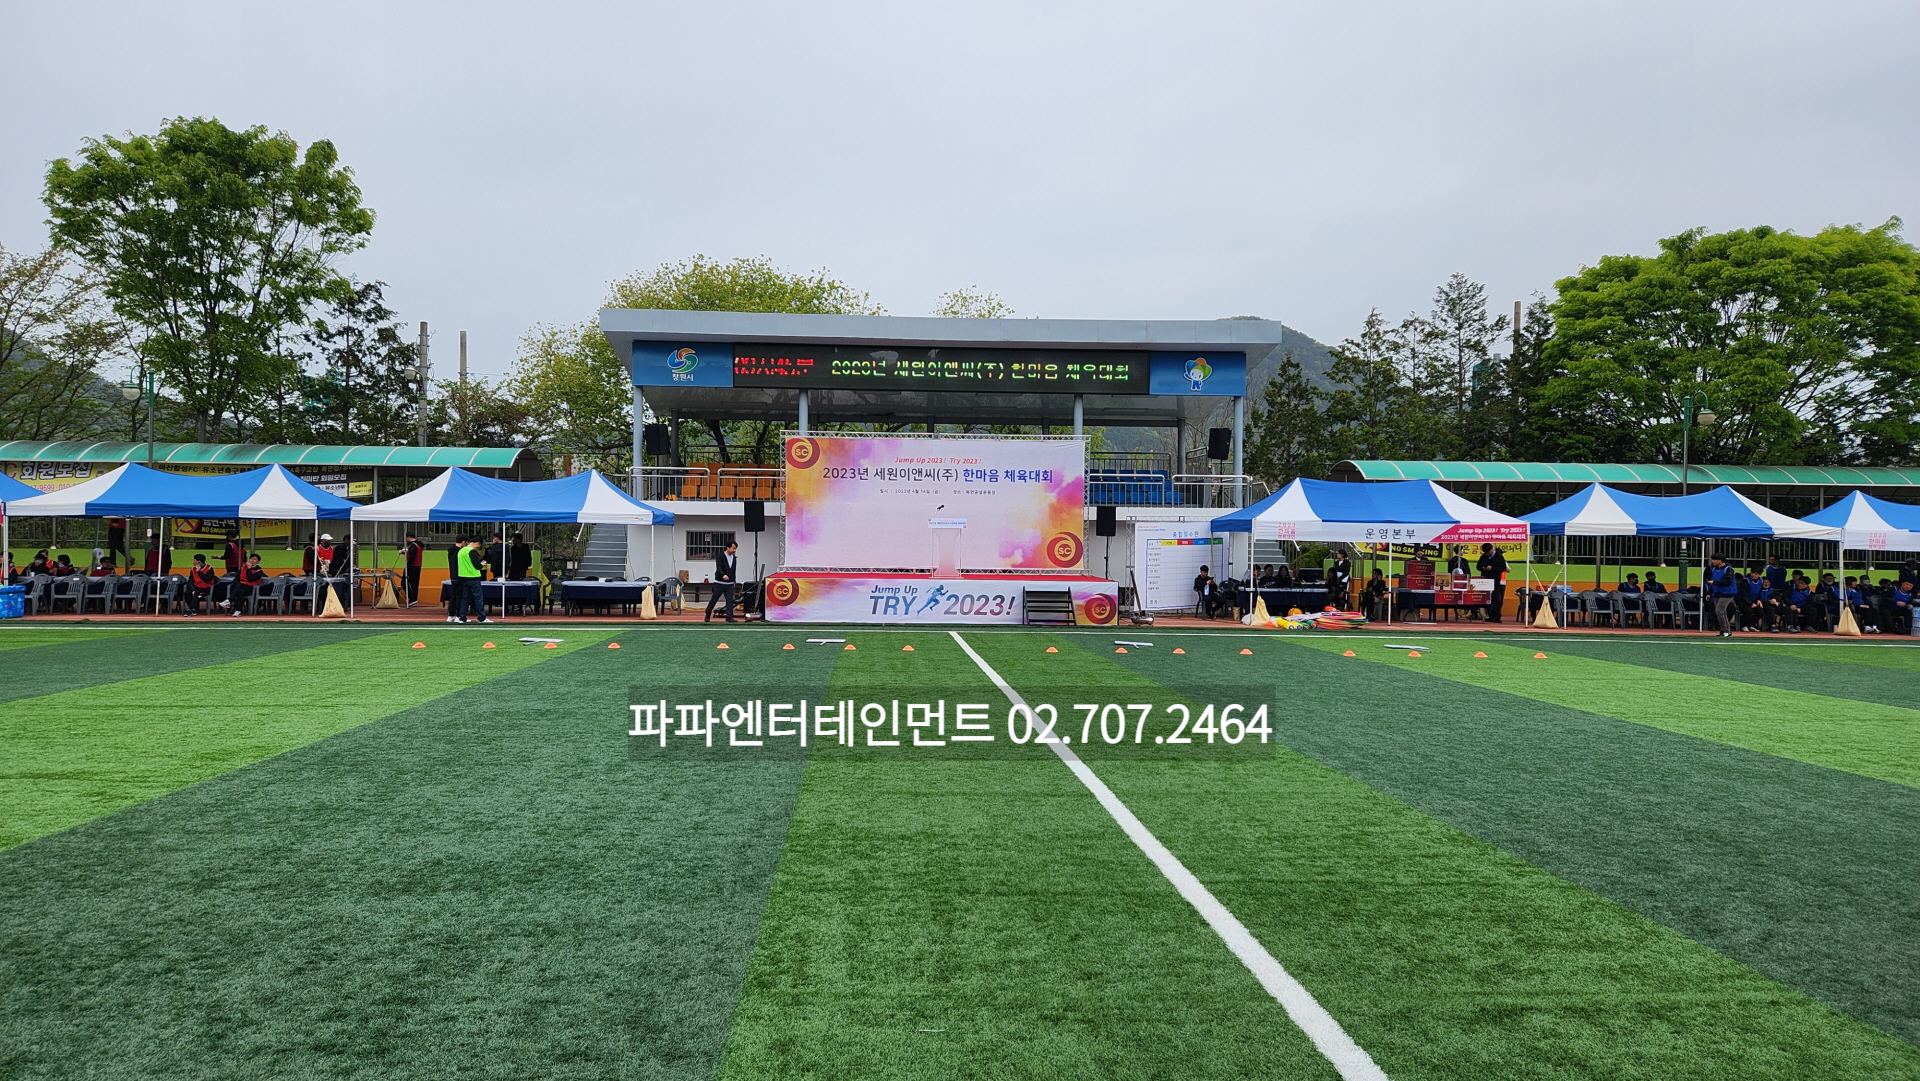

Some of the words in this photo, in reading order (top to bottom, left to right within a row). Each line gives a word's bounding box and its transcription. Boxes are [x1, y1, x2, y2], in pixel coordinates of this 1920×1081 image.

[671, 373, 694, 382] 창원시
[794, 448, 808, 457] SC
[894, 457, 914, 465] Jump
[916, 457, 926, 465] Up
[949, 457, 961, 465] Try
[20, 461, 94, 480] 회원모집
[822, 467, 869, 481] 2023년
[873, 467, 959, 482] 세원이앤씨(주)
[962, 468, 1000, 483] 한마음
[1003, 469, 1054, 484] 체육대회
[1364, 528, 1416, 540] 운영본부
[1058, 547, 1072, 555] SC
[871, 585, 900, 596] Jump
[904, 585, 918, 596] Up
[869, 595, 917, 616] TRY
[943, 594, 1016, 616] 2023!
[1094, 606, 1107, 614] SC
